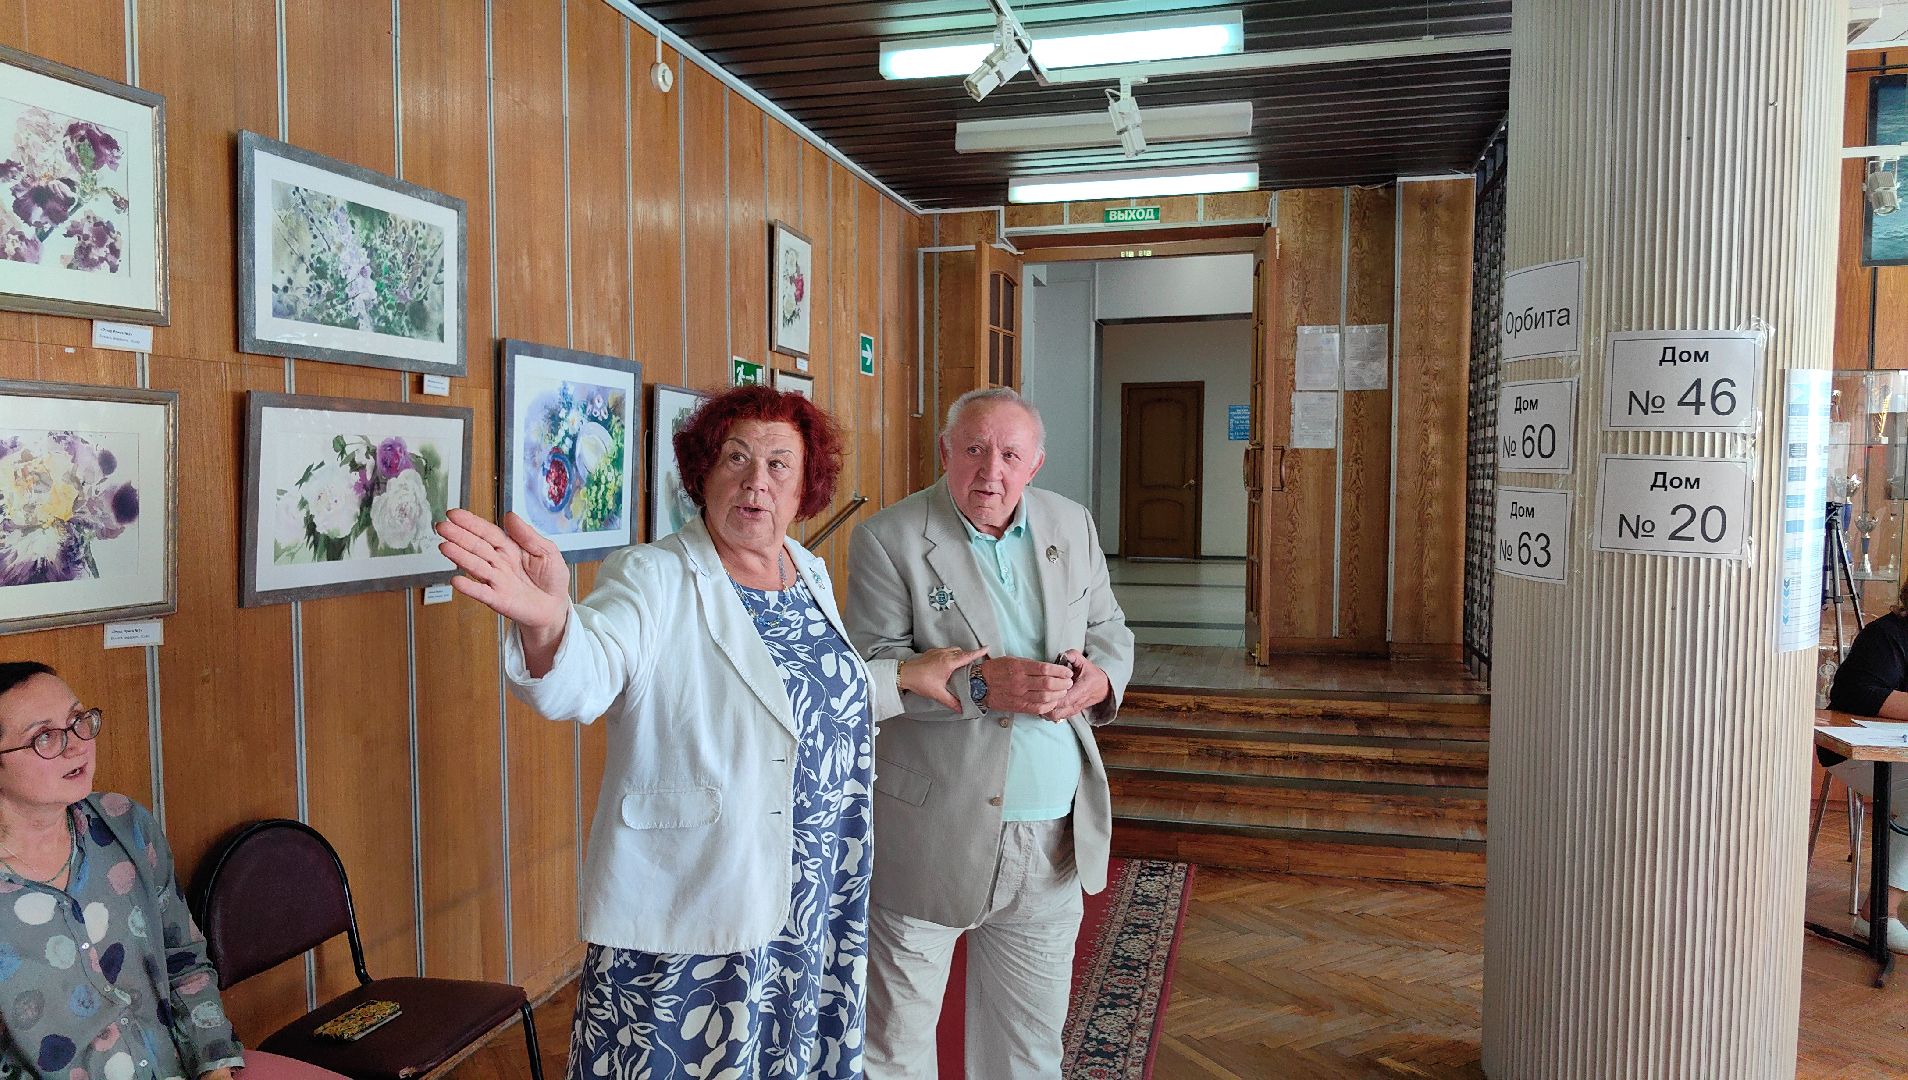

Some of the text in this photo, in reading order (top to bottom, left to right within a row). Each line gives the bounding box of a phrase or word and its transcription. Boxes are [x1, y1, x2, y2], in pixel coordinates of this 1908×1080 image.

[1109, 208, 1155, 221] ВЫХОД
[1505, 306, 1571, 339] Орбита
[1658, 346, 1709, 367] Дом
[1513, 395, 1539, 415] Дом
[1627, 377, 1737, 416] № 46
[1502, 423, 1556, 459] № 60
[1649, 471, 1701, 492] Дом
[1509, 501, 1535, 520] Дом
[1618, 503, 1727, 544] № 20
[1499, 531, 1552, 569] № 63
